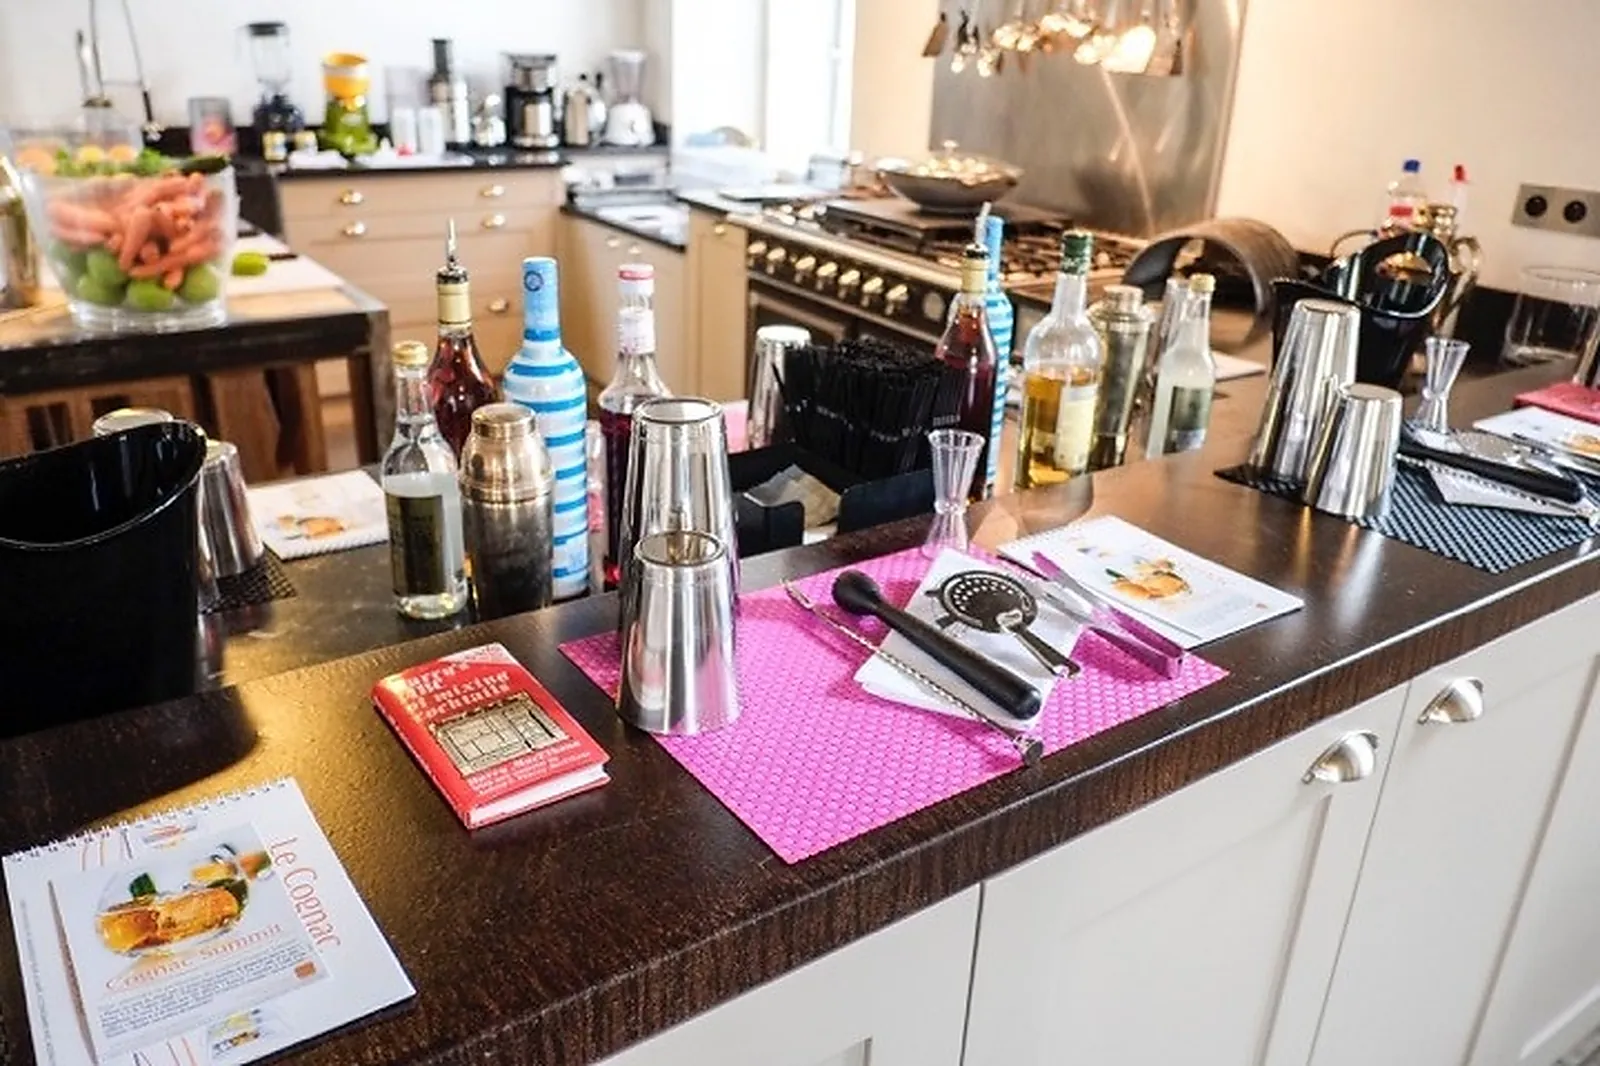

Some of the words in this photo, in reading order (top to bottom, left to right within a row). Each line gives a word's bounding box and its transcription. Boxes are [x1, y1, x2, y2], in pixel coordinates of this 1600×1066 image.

[411, 683, 511, 725] cocktails
[434, 670, 511, 702] mixing
[270, 837, 298, 867] Le
[284, 867, 342, 947] Cognac
[106, 957, 196, 992] Cognac
[199, 922, 283, 961] Summit
